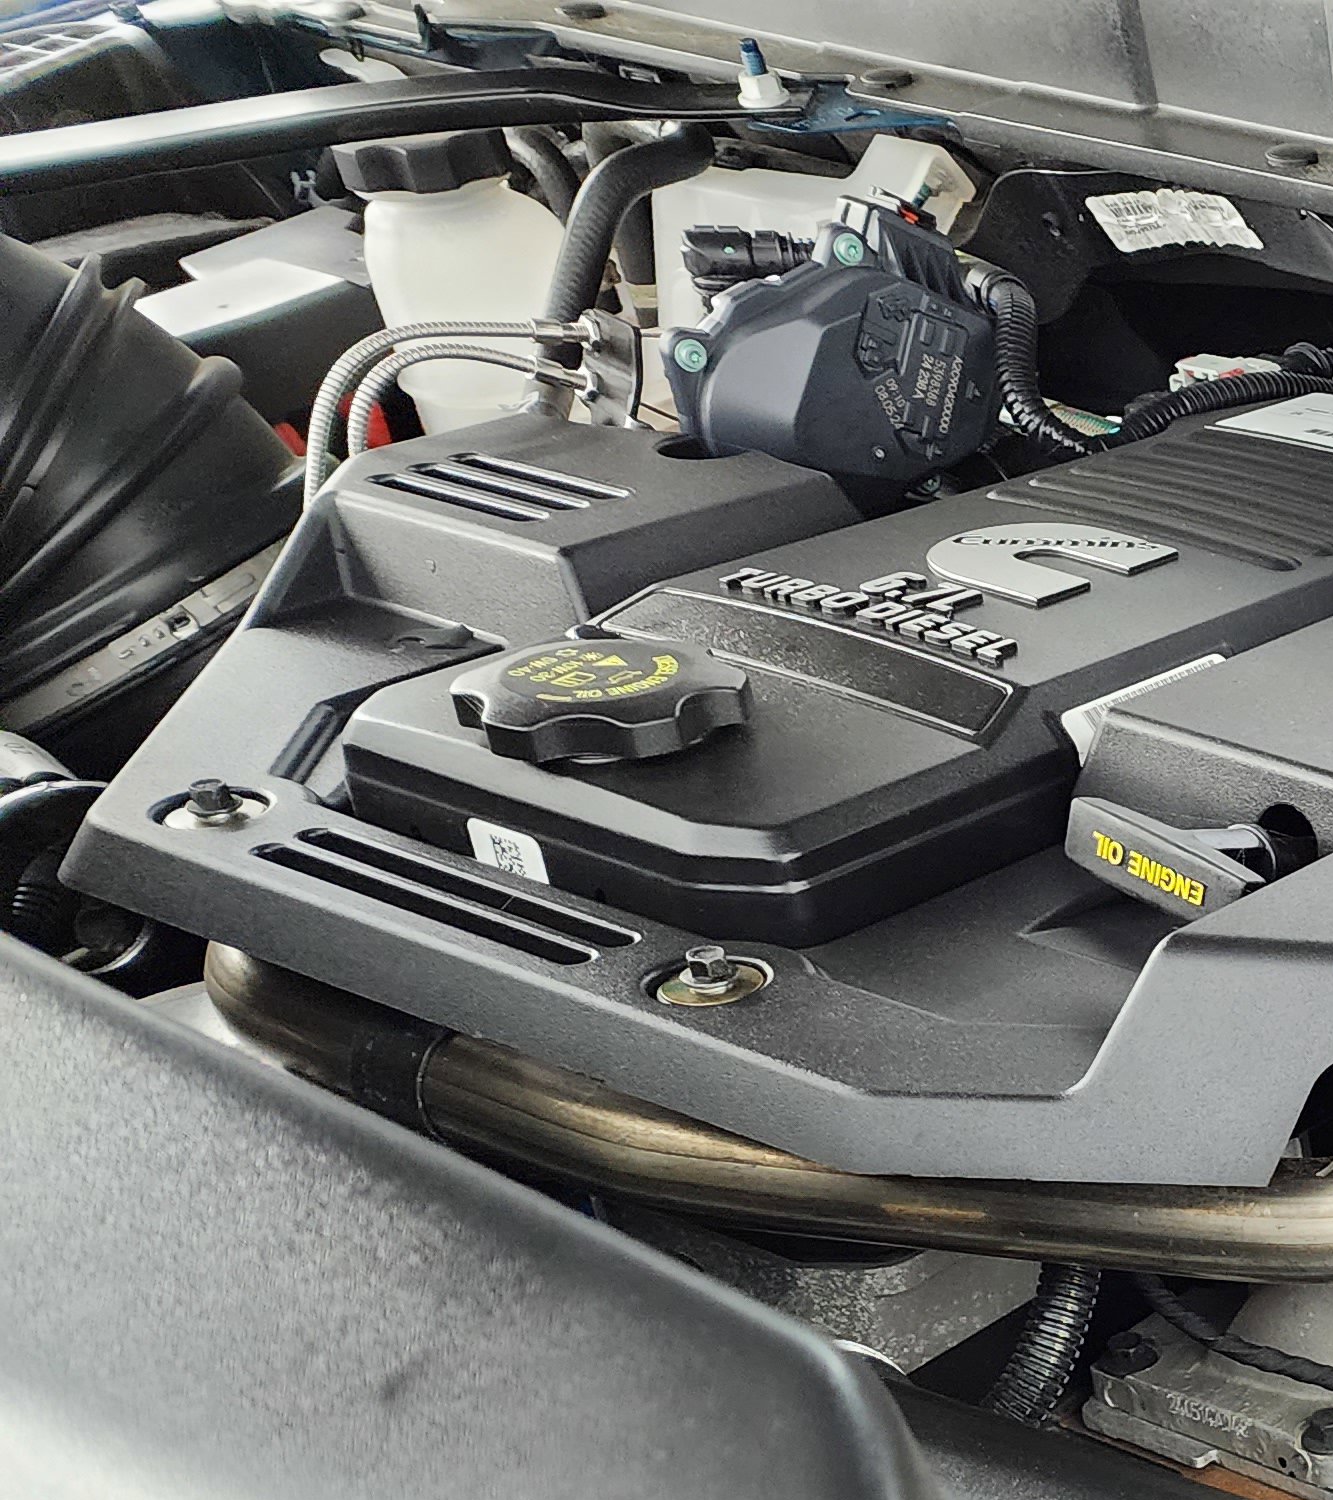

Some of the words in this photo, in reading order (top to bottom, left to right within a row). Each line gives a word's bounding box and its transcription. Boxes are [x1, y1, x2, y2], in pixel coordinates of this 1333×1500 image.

[952, 534, 1160, 551] Cummins
[719, 567, 869, 617] TURBO
[856, 601, 1018, 666] DIESEL
[1092, 830, 1124, 867] OIL
[1127, 849, 1206, 906] ENGINE
